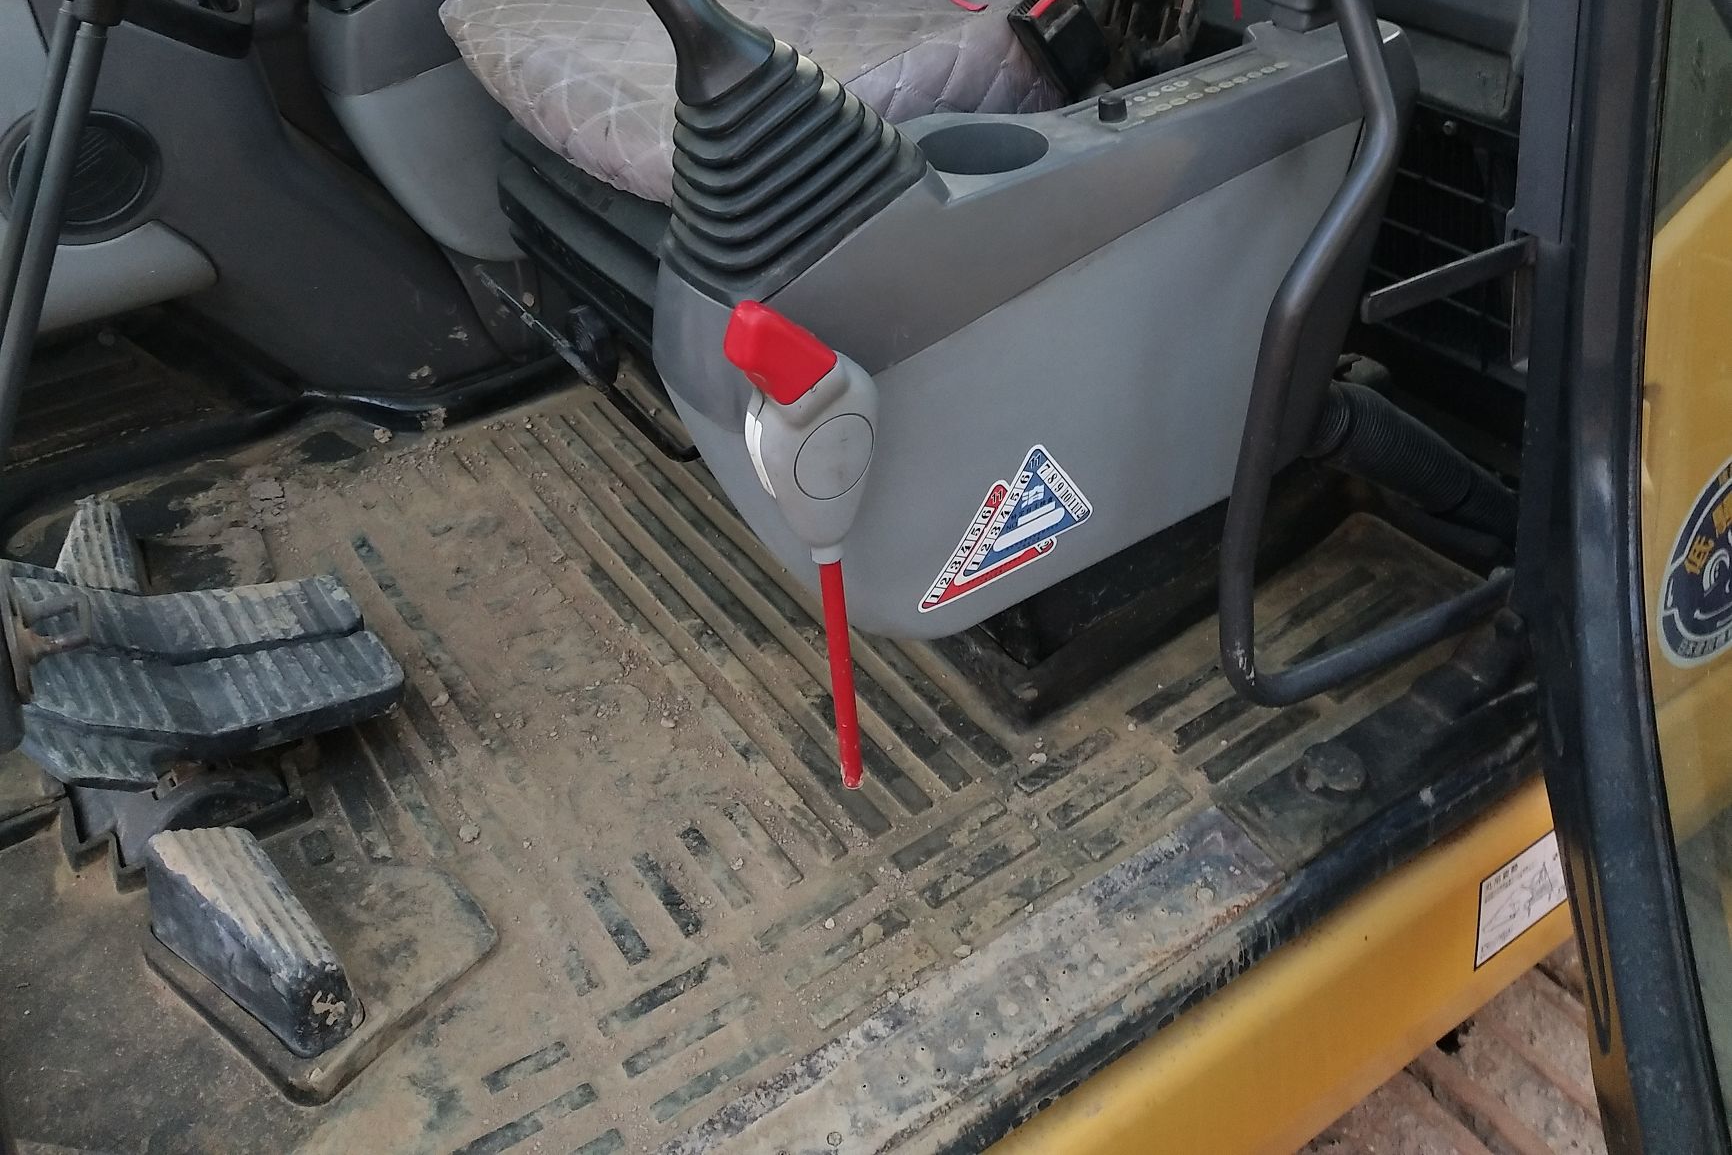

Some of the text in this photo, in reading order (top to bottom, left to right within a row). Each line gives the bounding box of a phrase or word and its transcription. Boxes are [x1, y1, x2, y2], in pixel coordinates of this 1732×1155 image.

[981, 543, 991, 551] 2
[991, 526, 1001, 535] 3
[1001, 511, 1010, 519] 4
[1010, 492, 1019, 501] 5
[1020, 474, 1030, 484] 6
[1041, 464, 1050, 474] 7
[1048, 474, 1057, 484] 8
[1055, 482, 1064, 492] 9
[940, 577, 951, 585] 2
[950, 560, 961, 569] 3
[961, 546, 971, 554] 4
[971, 528, 981, 536] 5
[982, 510, 991, 519] 6
